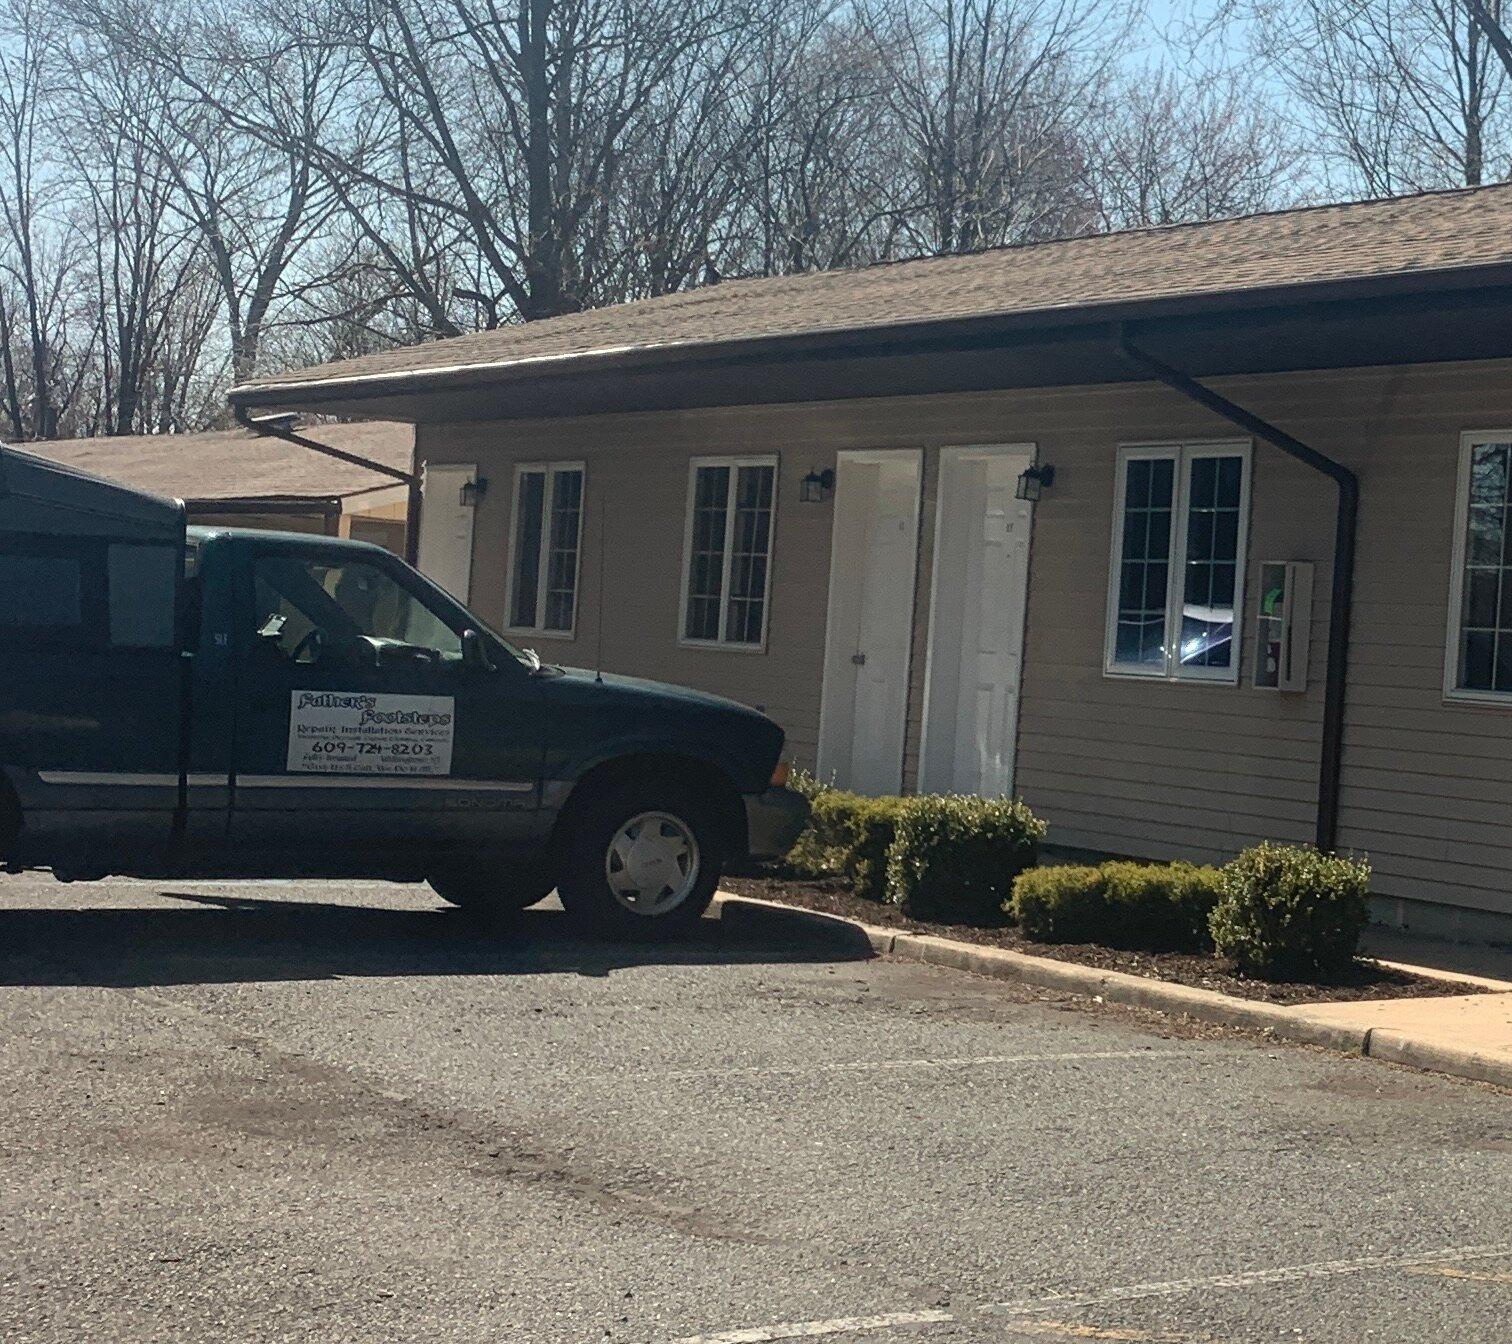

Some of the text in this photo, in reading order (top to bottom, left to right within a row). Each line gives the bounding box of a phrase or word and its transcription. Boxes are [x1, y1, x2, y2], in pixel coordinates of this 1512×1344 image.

[297, 692, 377, 711] Father's
[359, 709, 452, 727] Footsteps
[312, 741, 434, 755] 609-724-8203
